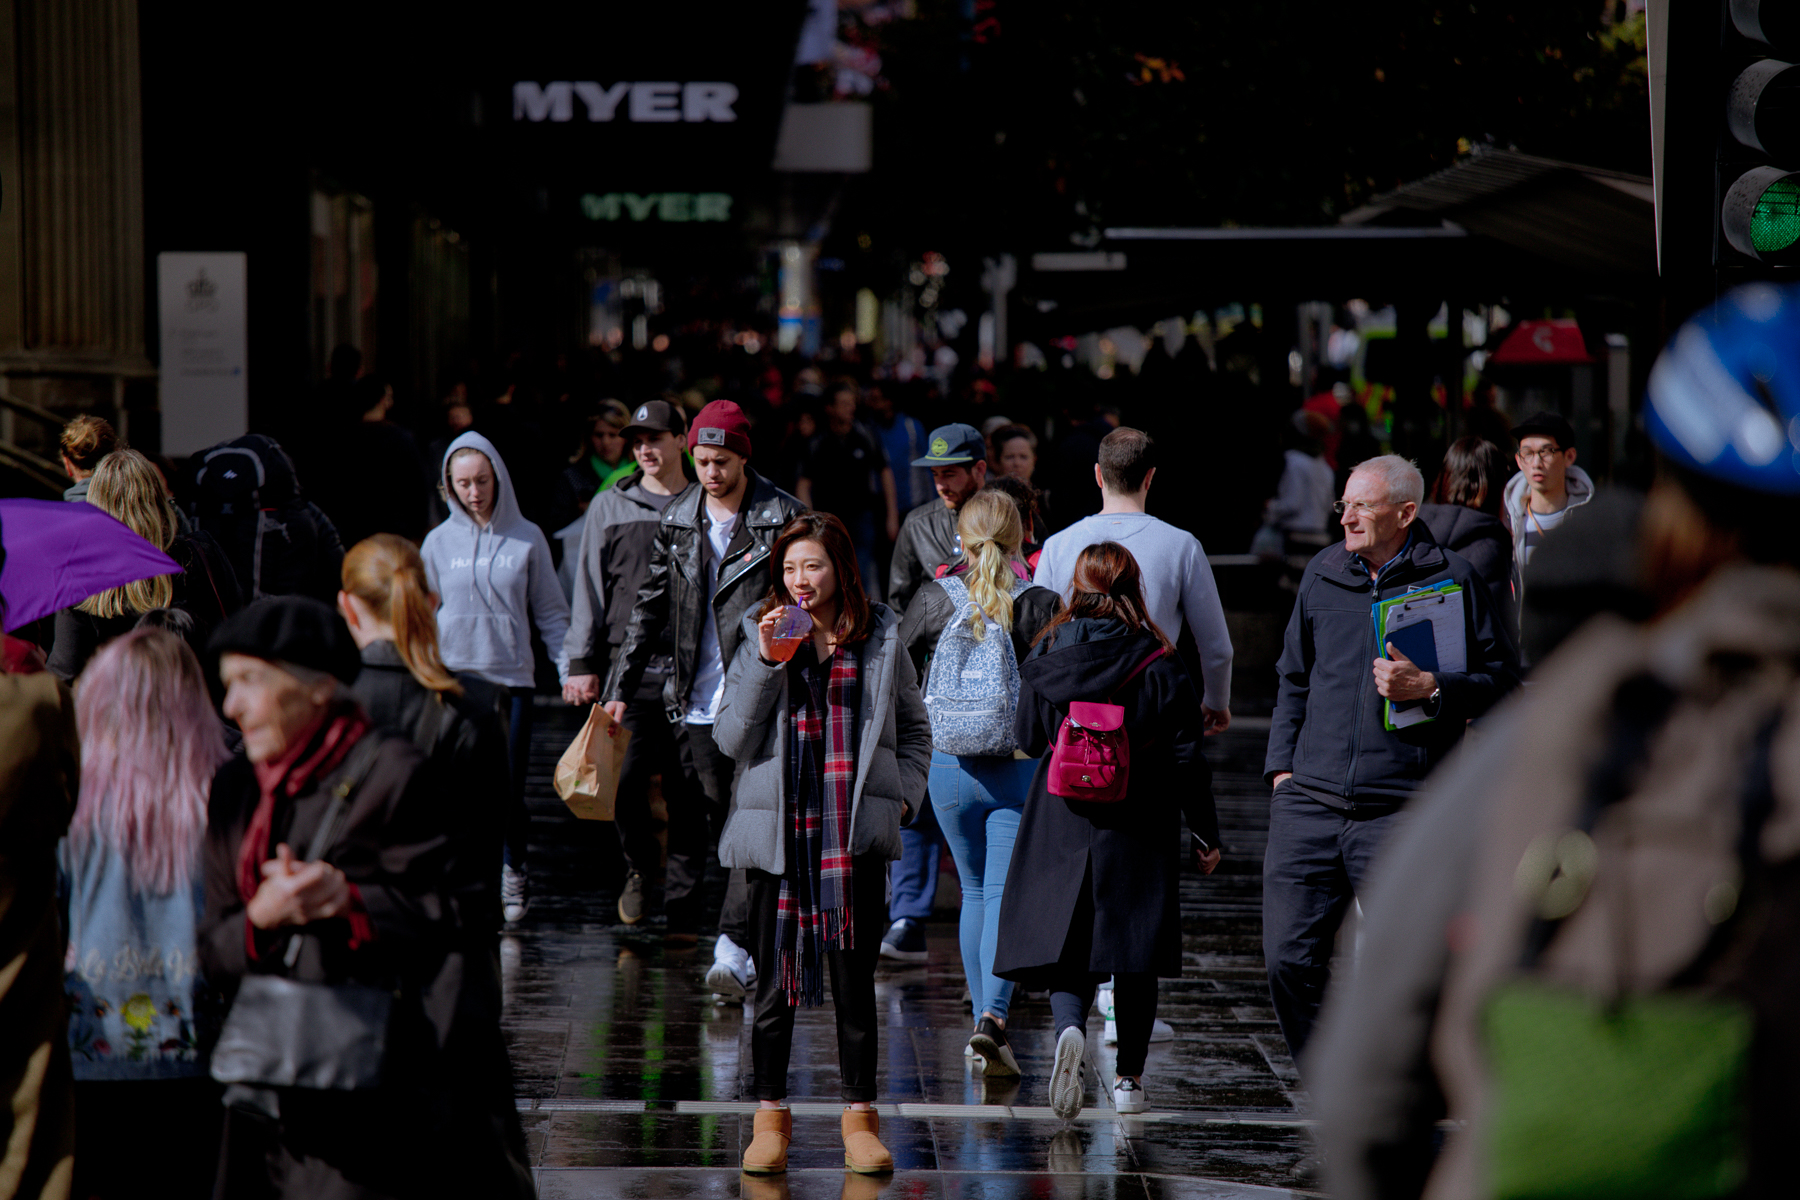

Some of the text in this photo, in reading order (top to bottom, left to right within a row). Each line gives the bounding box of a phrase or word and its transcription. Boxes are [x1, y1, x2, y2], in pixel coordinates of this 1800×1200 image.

[512, 81, 738, 122] MYER
[581, 192, 732, 221] MYER
[450, 557, 498, 570] Hue
